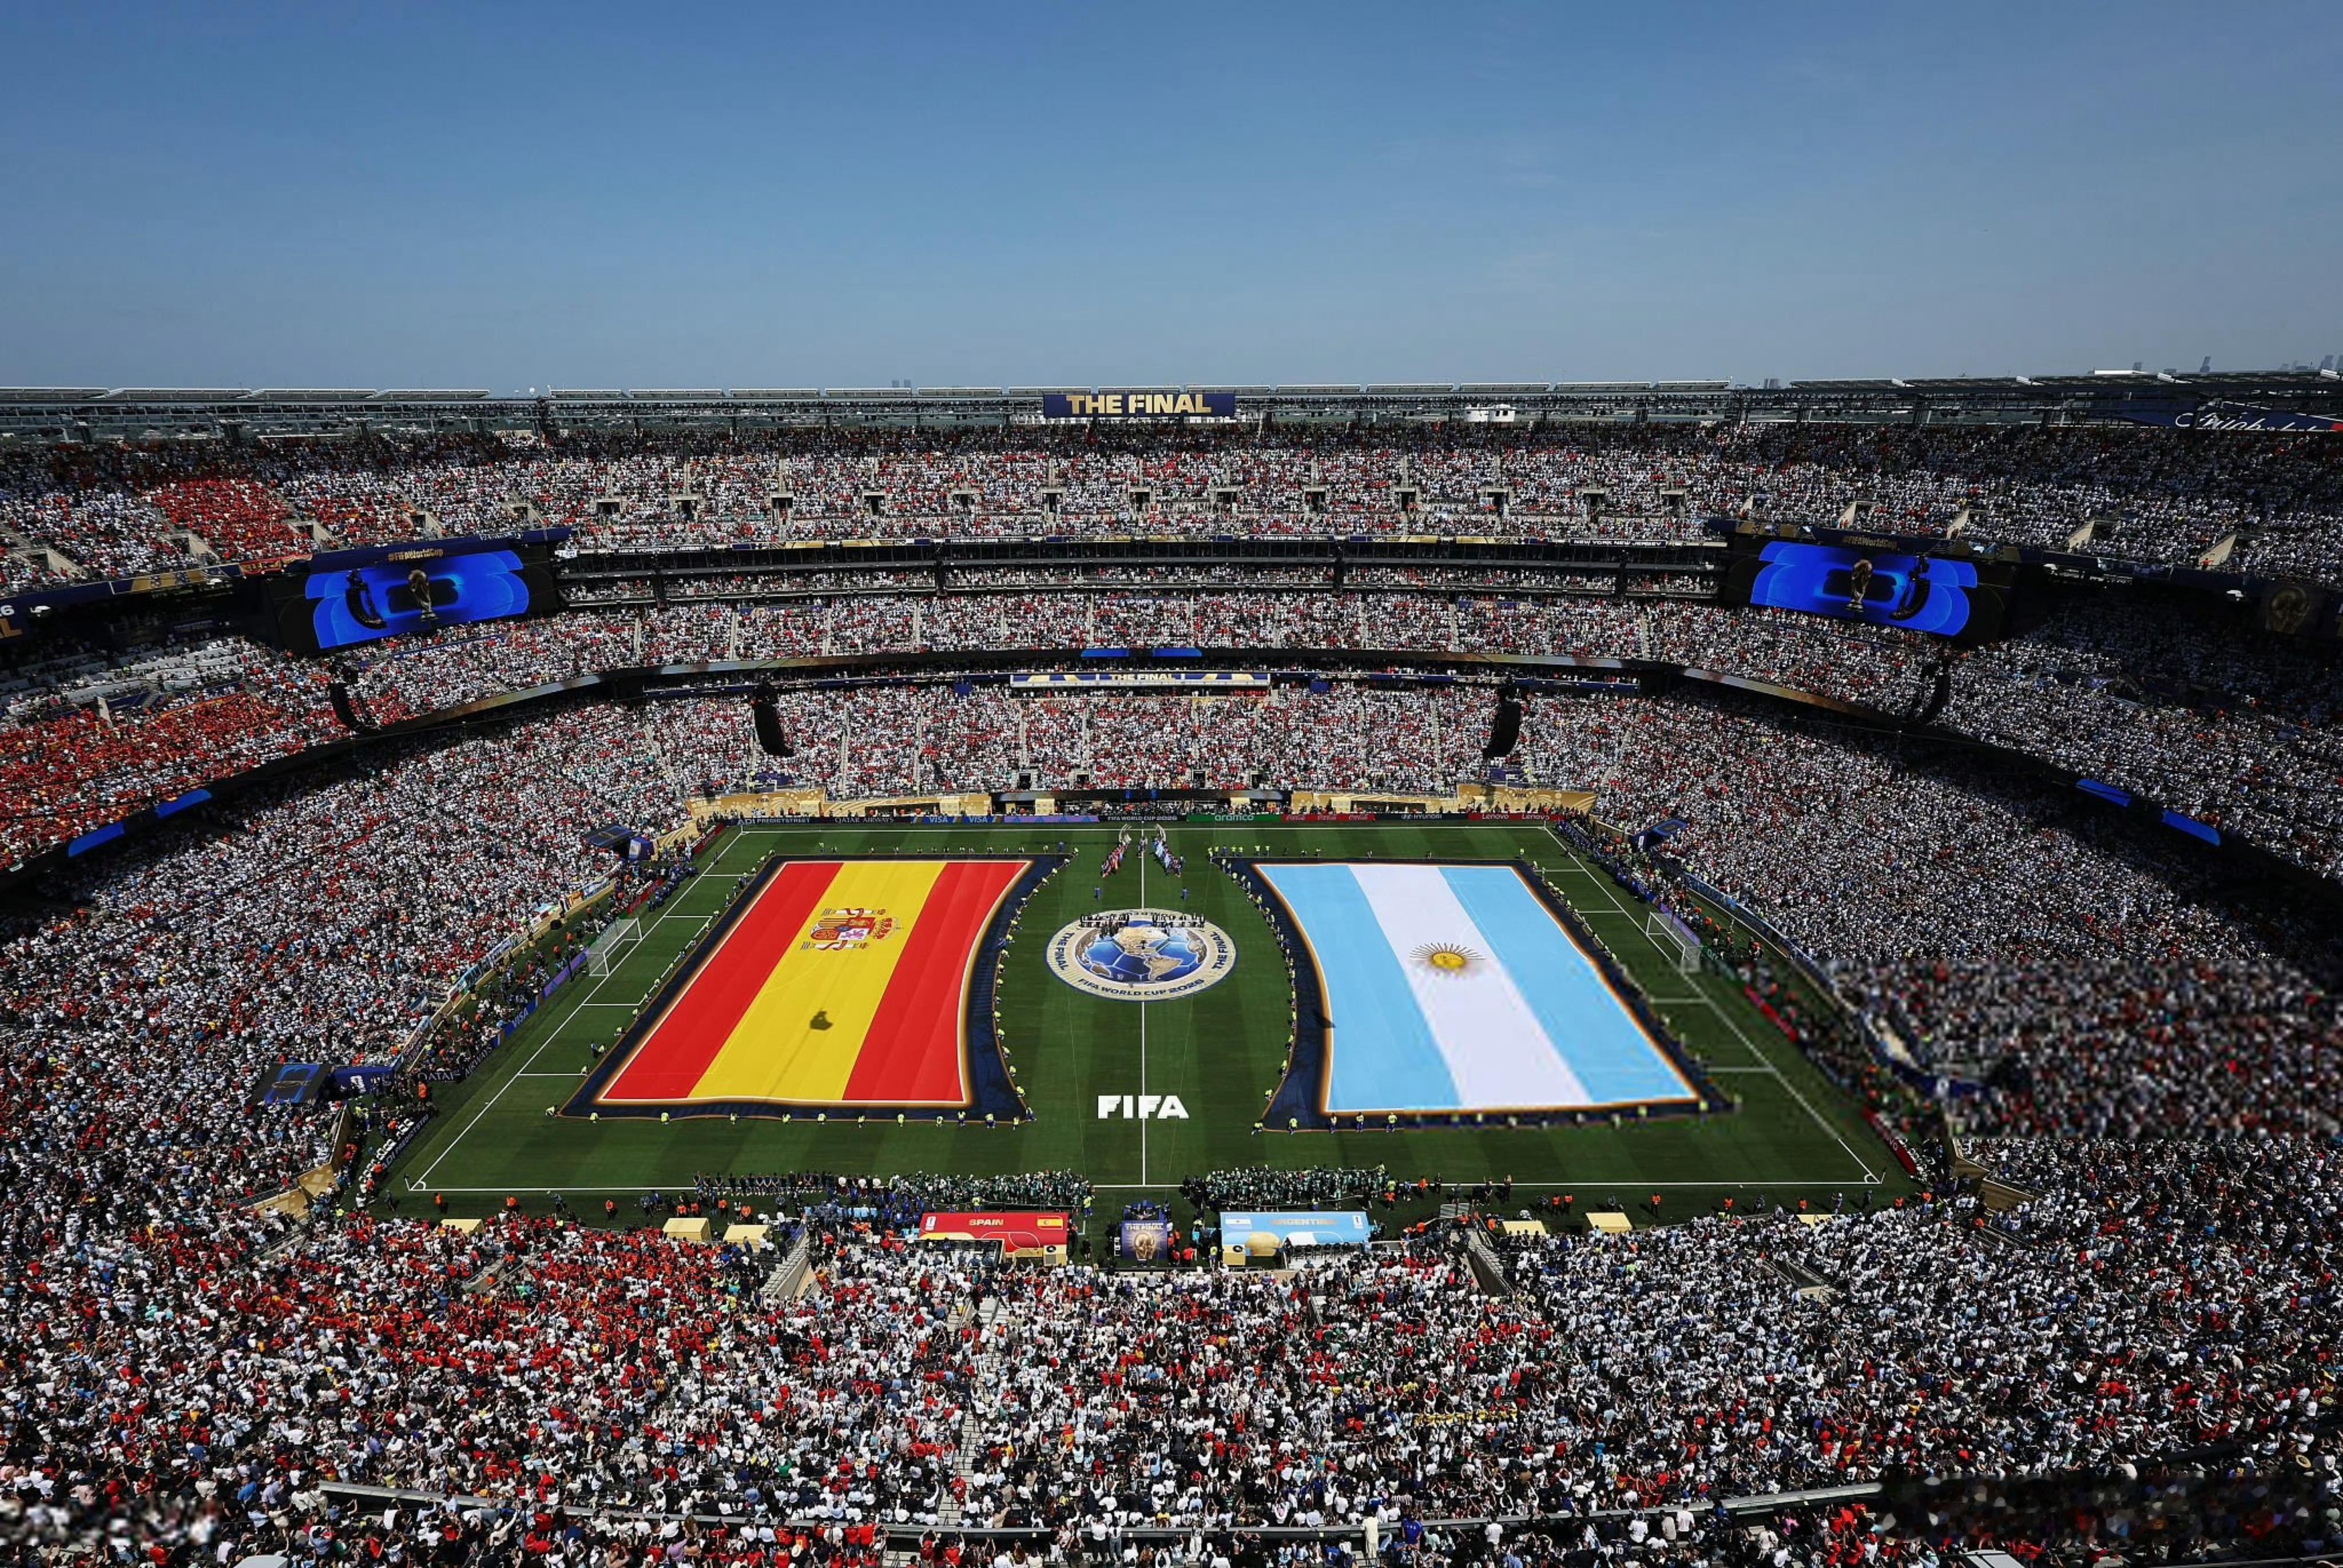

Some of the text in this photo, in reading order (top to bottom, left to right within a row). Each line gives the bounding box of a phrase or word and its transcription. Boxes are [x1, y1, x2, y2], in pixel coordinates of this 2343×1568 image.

[1066, 395, 1211, 414] THE FINAL
[0, 604, 15, 617] 6
[0, 618, 23, 639] L
[1137, 674, 1176, 682] FINAL
[1055, 933, 1074, 970] THE FINAL
[1210, 932, 1228, 969] THE FINAL
[1078, 978, 1099, 990] FIFA
[1102, 986, 1141, 996] WORLD
[1169, 978, 1204, 993] 2026
[512, 1009, 529, 1028] VISA
[1098, 1096, 1189, 1119] FIFA
